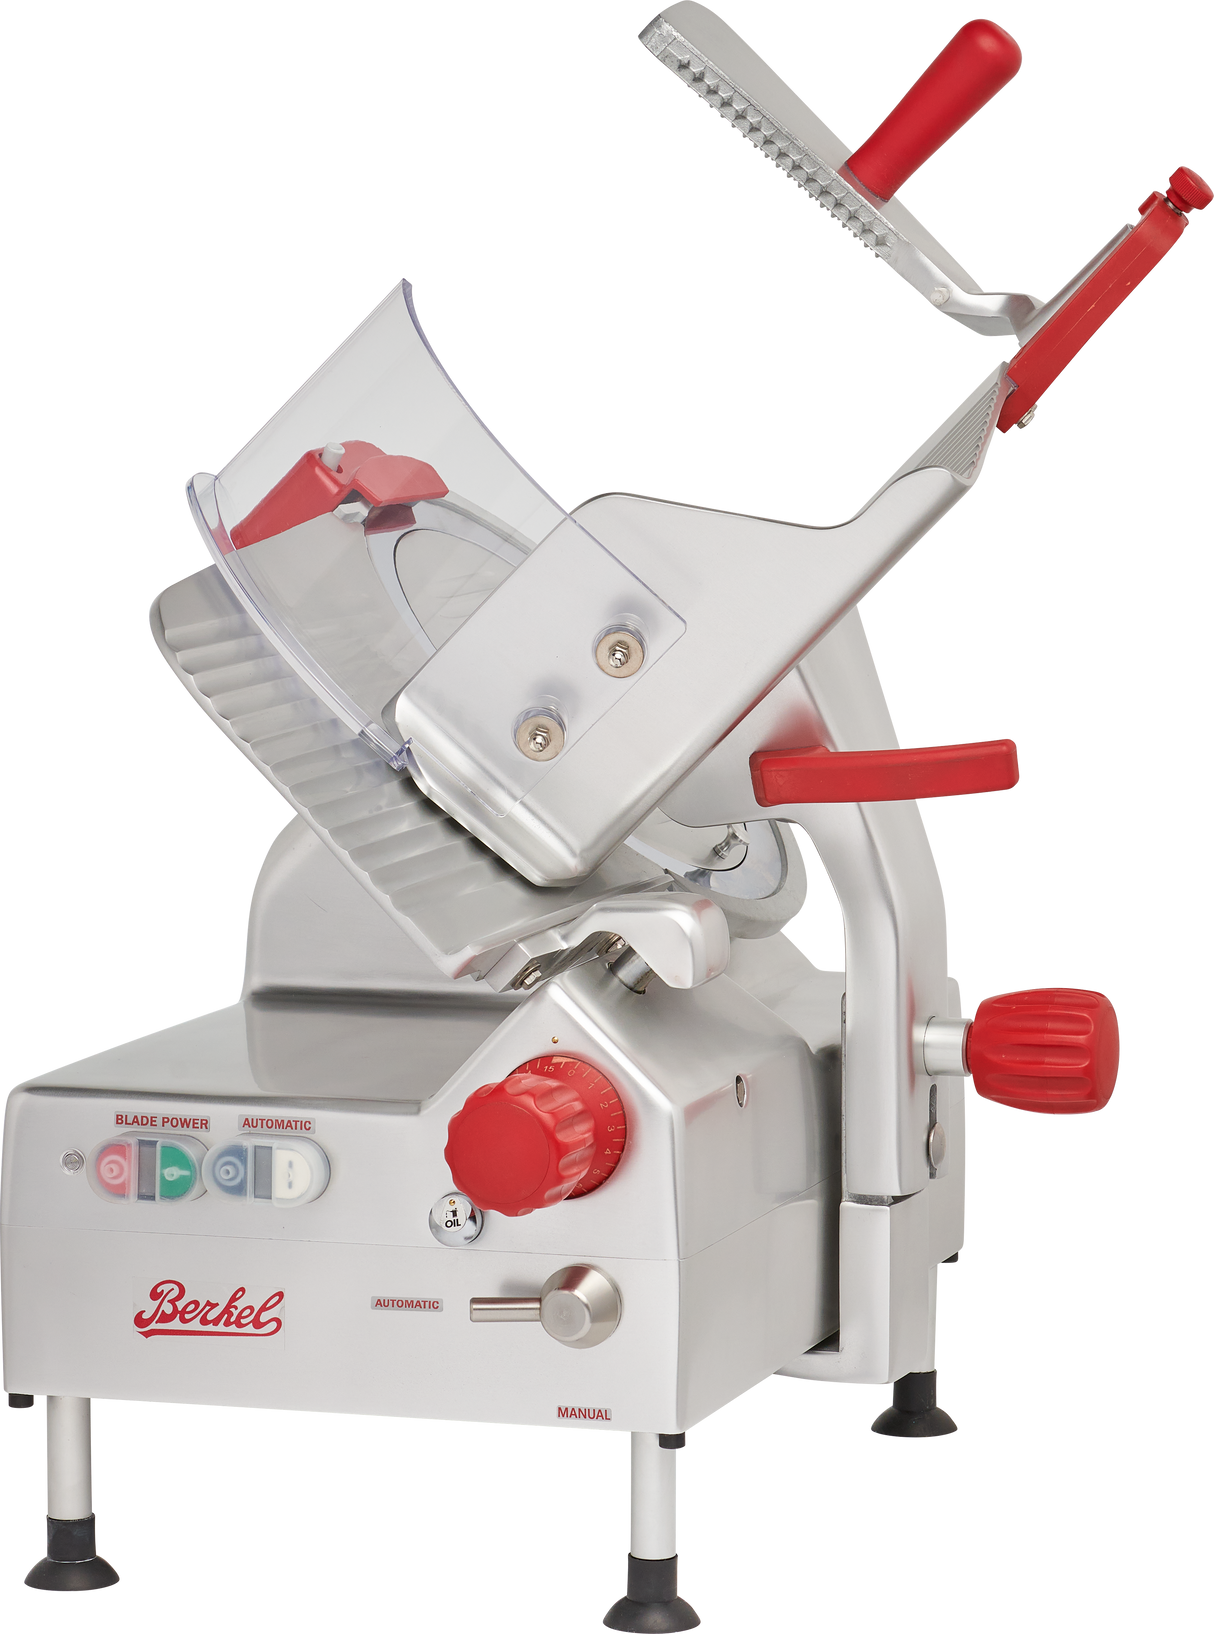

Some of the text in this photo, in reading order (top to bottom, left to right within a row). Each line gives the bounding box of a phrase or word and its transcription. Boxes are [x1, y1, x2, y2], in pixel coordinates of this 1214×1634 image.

[600, 1101, 608, 1109] 2
[115, 1113, 209, 1130] BLADE POWER
[242, 1117, 312, 1131] AUTOMATIC
[445, 1218, 461, 1228] OIL
[134, 1279, 285, 1339] Berkel
[375, 1298, 440, 1310] AUTOMATIC
[557, 1407, 611, 1421] MANUAL
